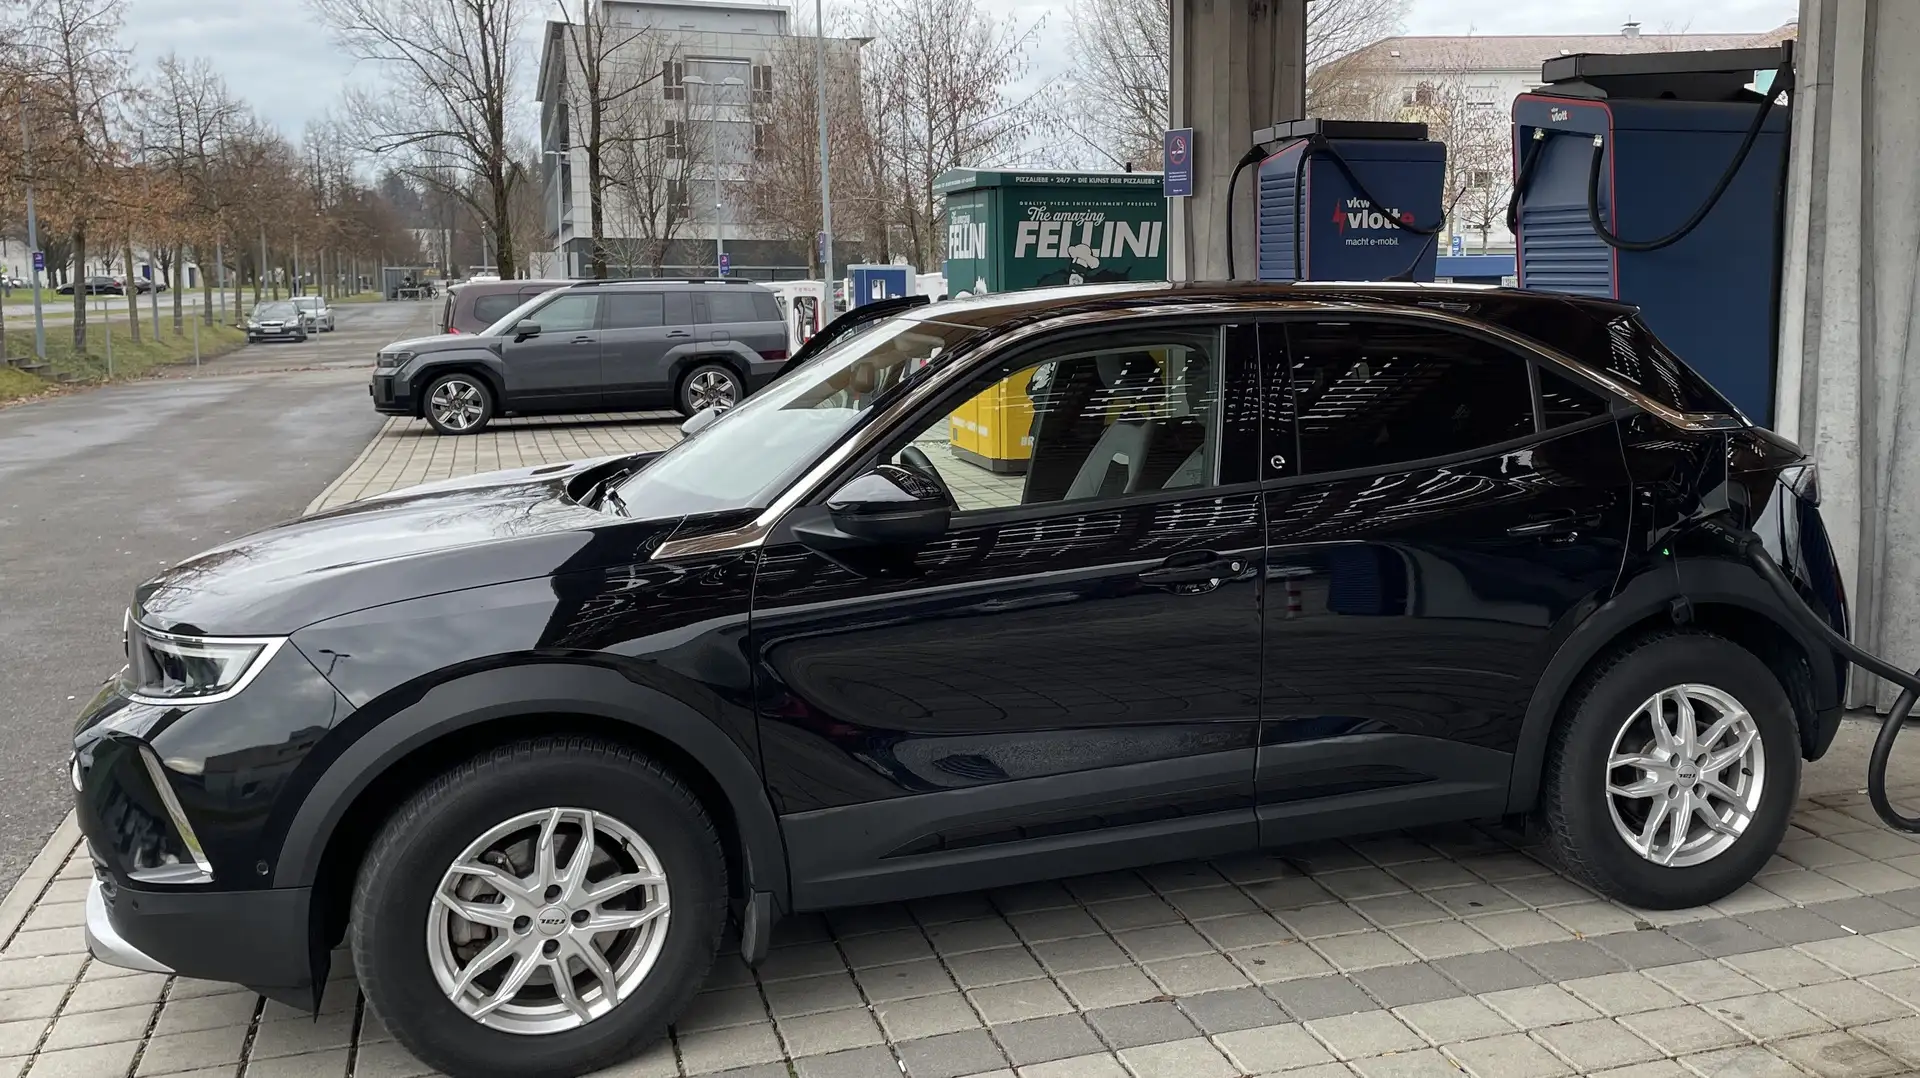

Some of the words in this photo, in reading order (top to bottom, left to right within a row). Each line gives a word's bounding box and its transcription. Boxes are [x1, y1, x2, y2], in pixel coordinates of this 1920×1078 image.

[1346, 196, 1370, 208] vkw
[1027, 206, 1052, 221] The
[1053, 209, 1106, 227] amazing
[948, 222, 986, 260] FELLINI
[1014, 221, 1163, 258] FELLINI
[1345, 237, 1369, 246] macht
